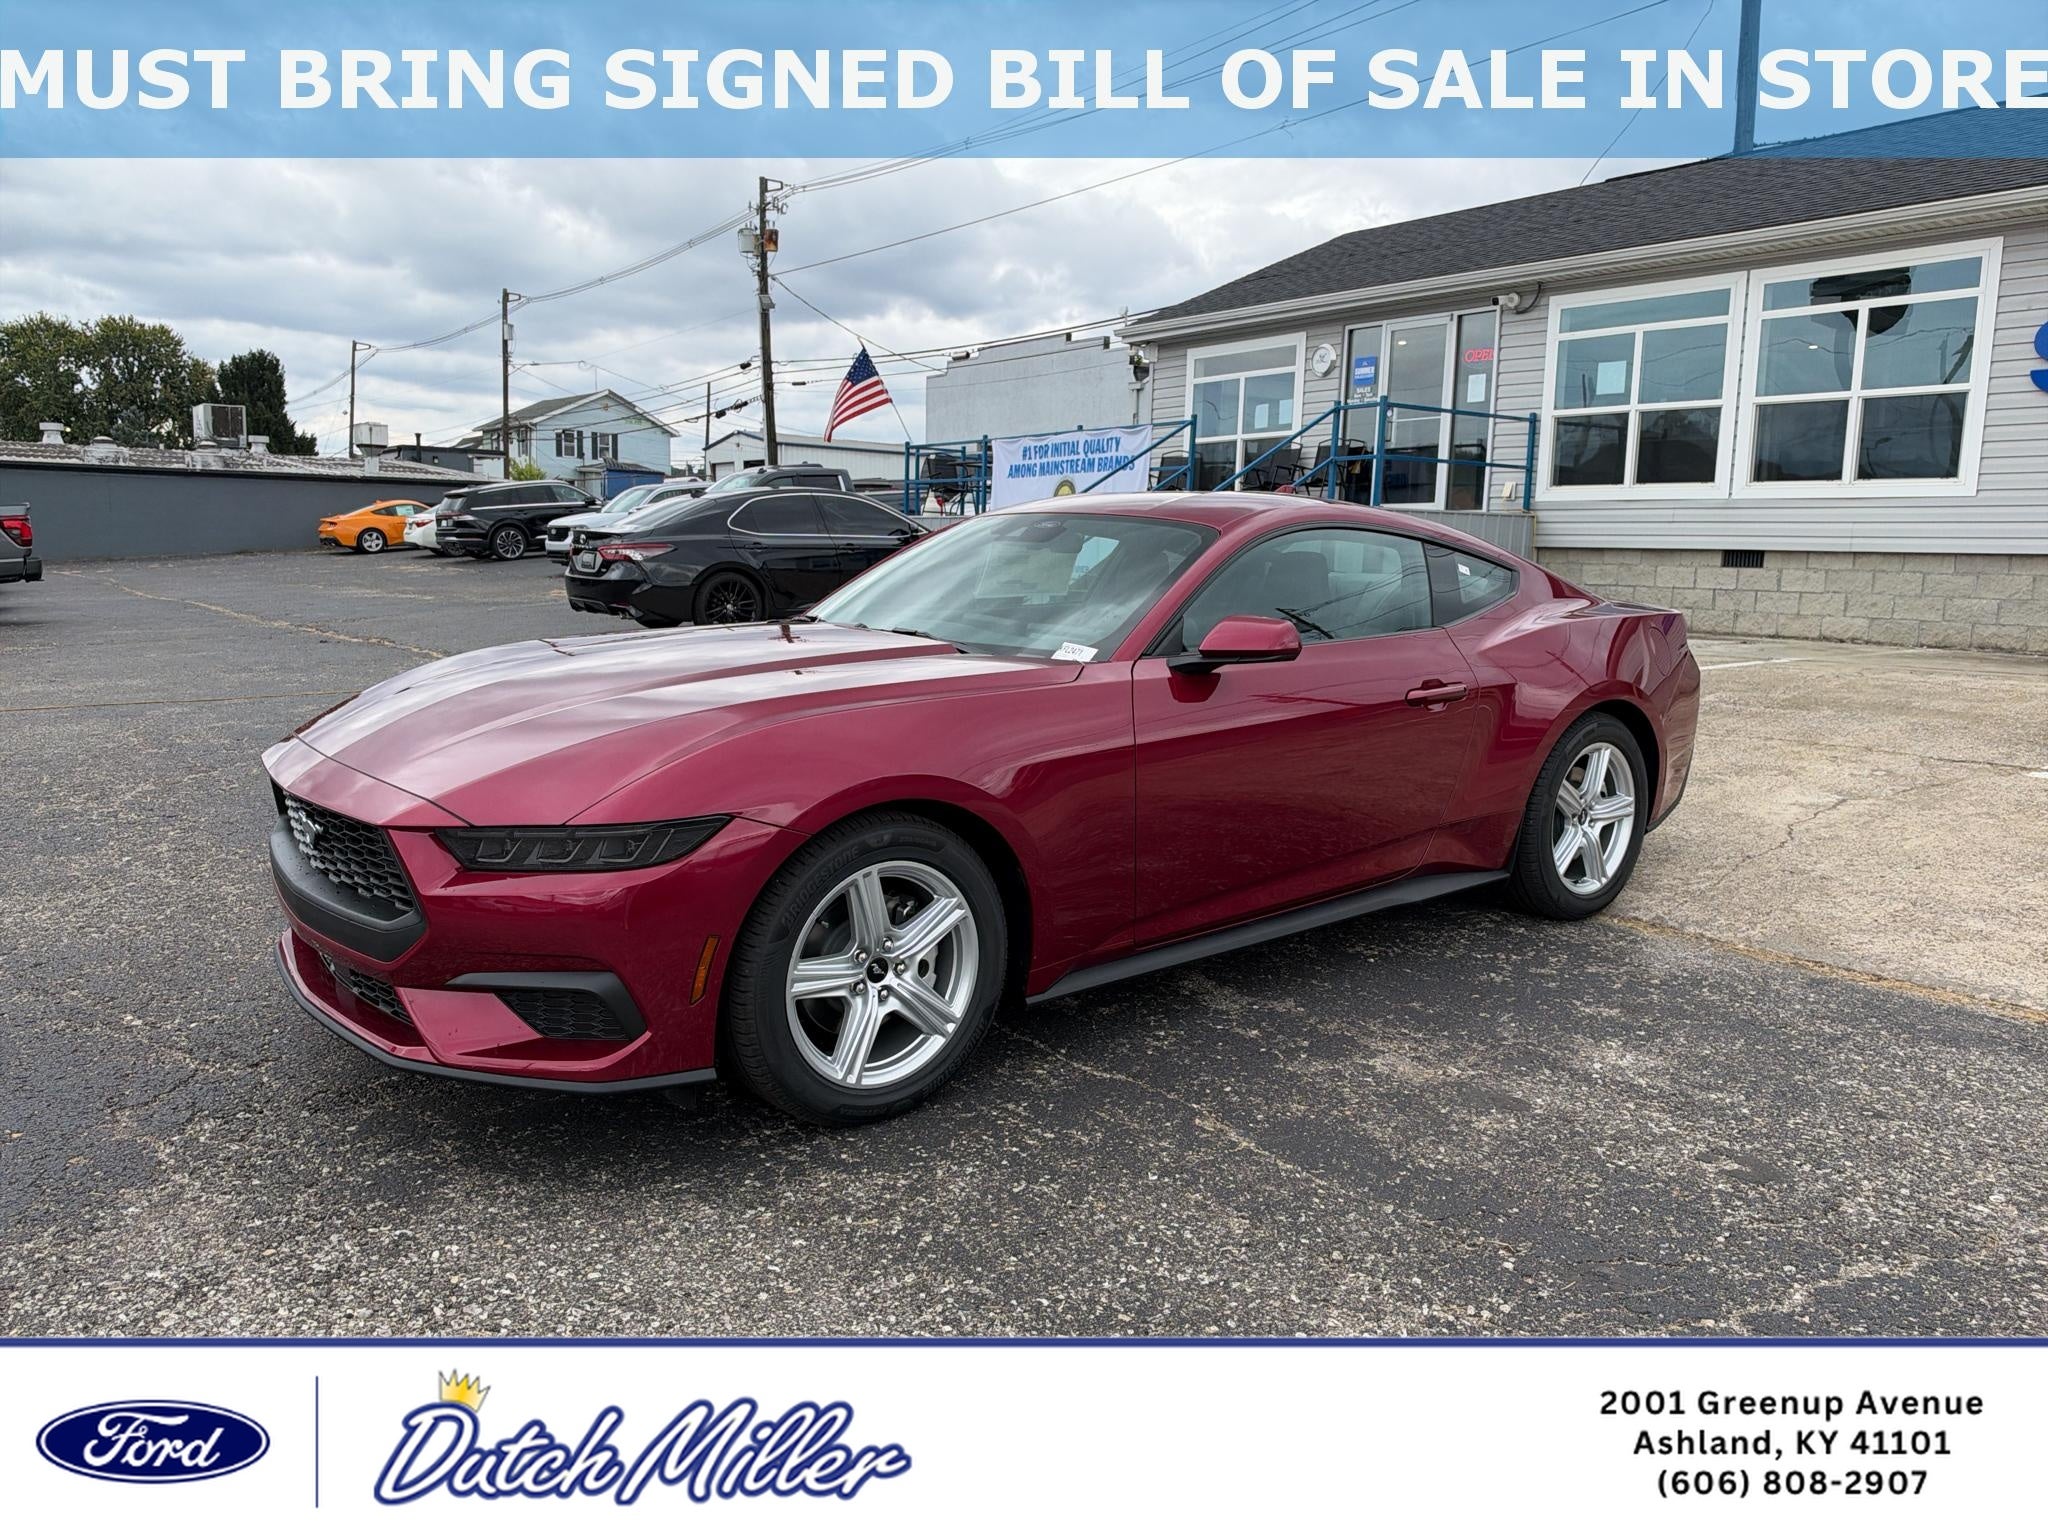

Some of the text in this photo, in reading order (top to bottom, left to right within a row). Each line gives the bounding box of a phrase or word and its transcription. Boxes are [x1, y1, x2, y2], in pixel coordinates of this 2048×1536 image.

[1022, 436, 1121, 461] #1 FOR INITIAL QUALITY
[1007, 461, 1037, 478] AMONG
[1038, 457, 1095, 476] MAINSTREAM
